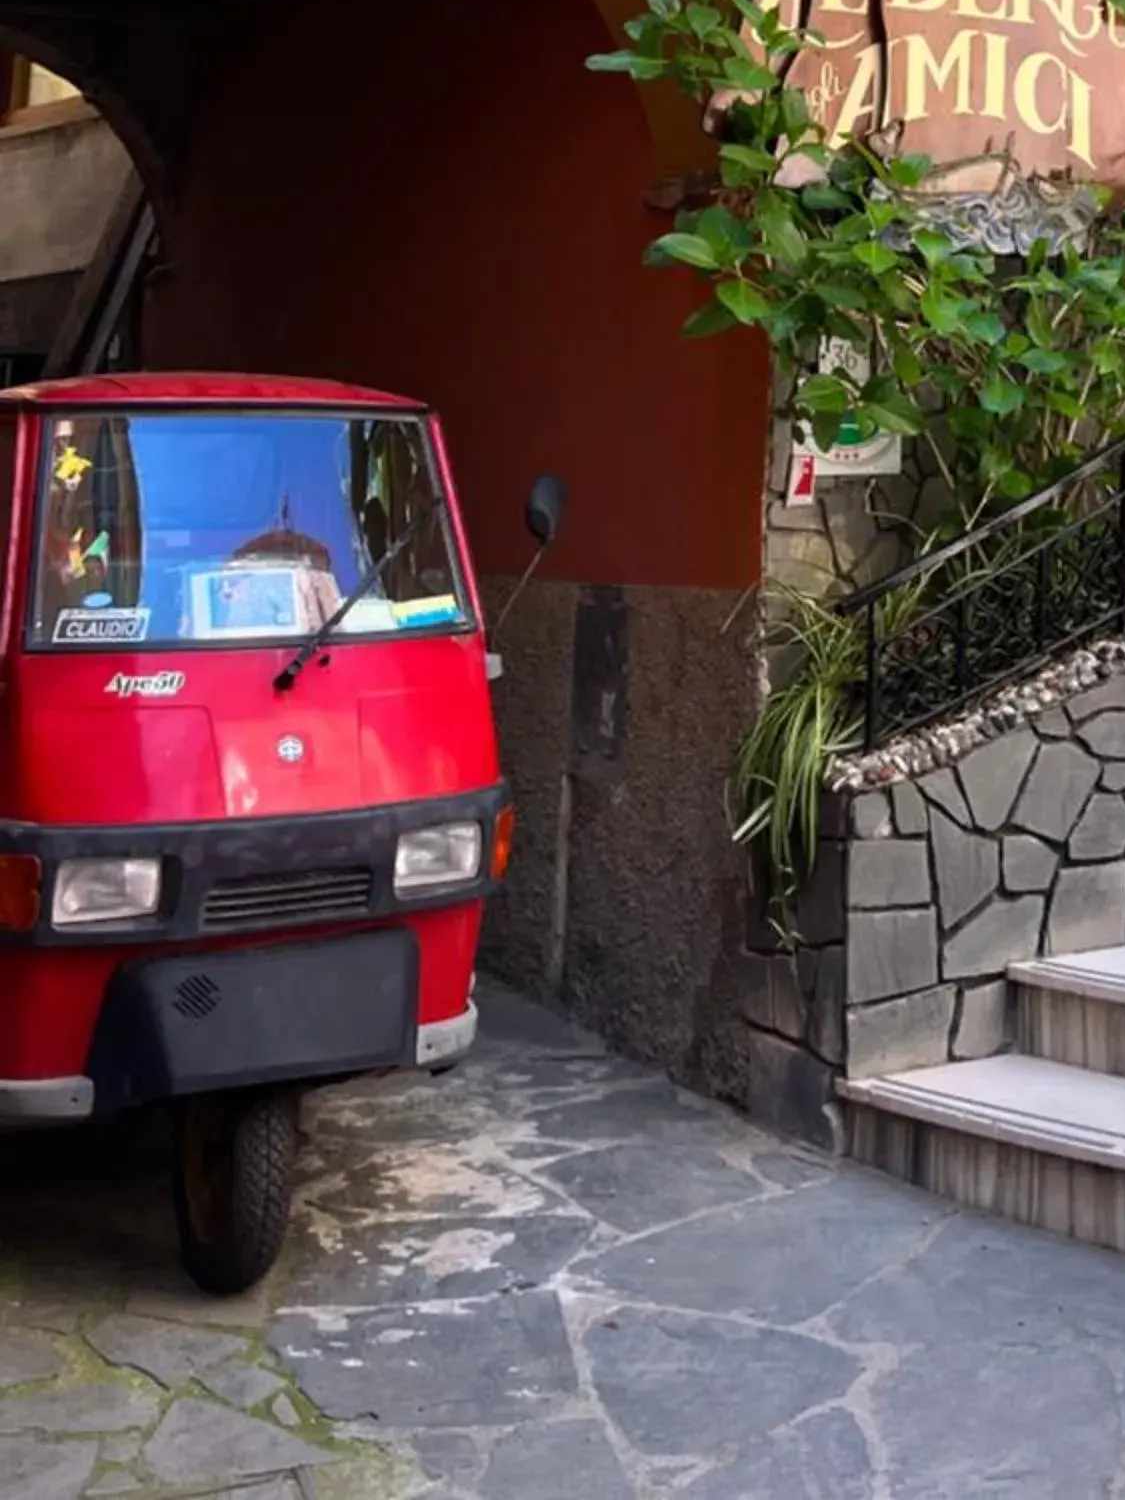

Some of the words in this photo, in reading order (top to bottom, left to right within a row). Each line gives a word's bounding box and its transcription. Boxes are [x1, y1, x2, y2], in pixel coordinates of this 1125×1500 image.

[805, 61, 847, 132] gli
[828, 29, 1097, 172] AMICI
[65, 620, 138, 637] CLAUDIO
